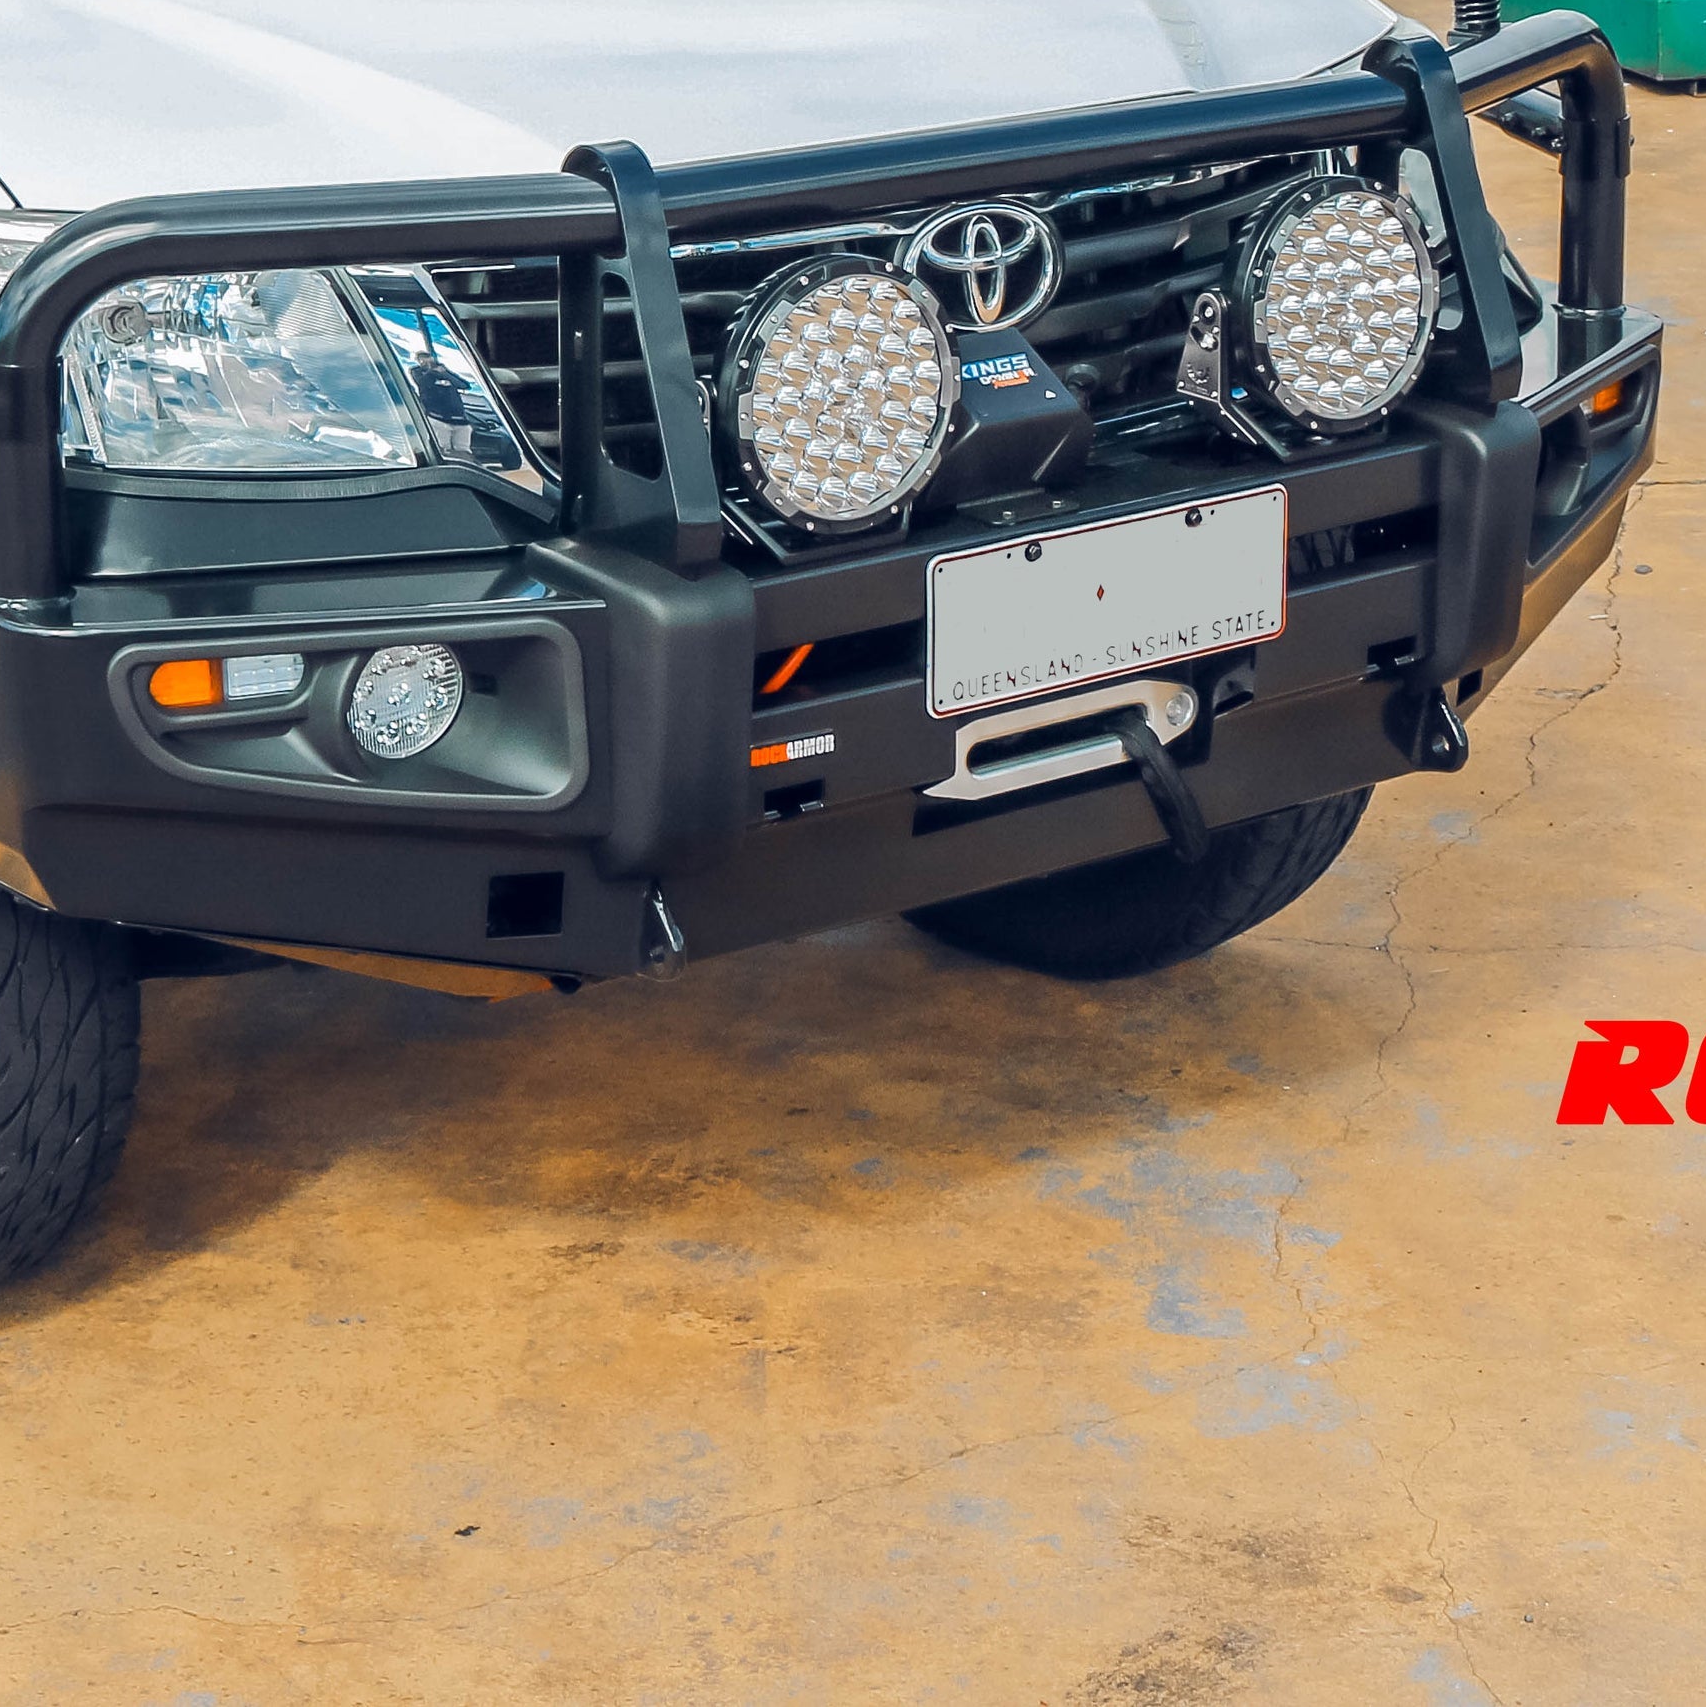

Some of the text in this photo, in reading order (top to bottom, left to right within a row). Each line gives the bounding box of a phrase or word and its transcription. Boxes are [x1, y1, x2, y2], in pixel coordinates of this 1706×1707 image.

[952, 653, 1084, 701] QUEENSLAND
[1106, 625, 1200, 666] SUNSHINE
[1212, 609, 1268, 640] STATE
